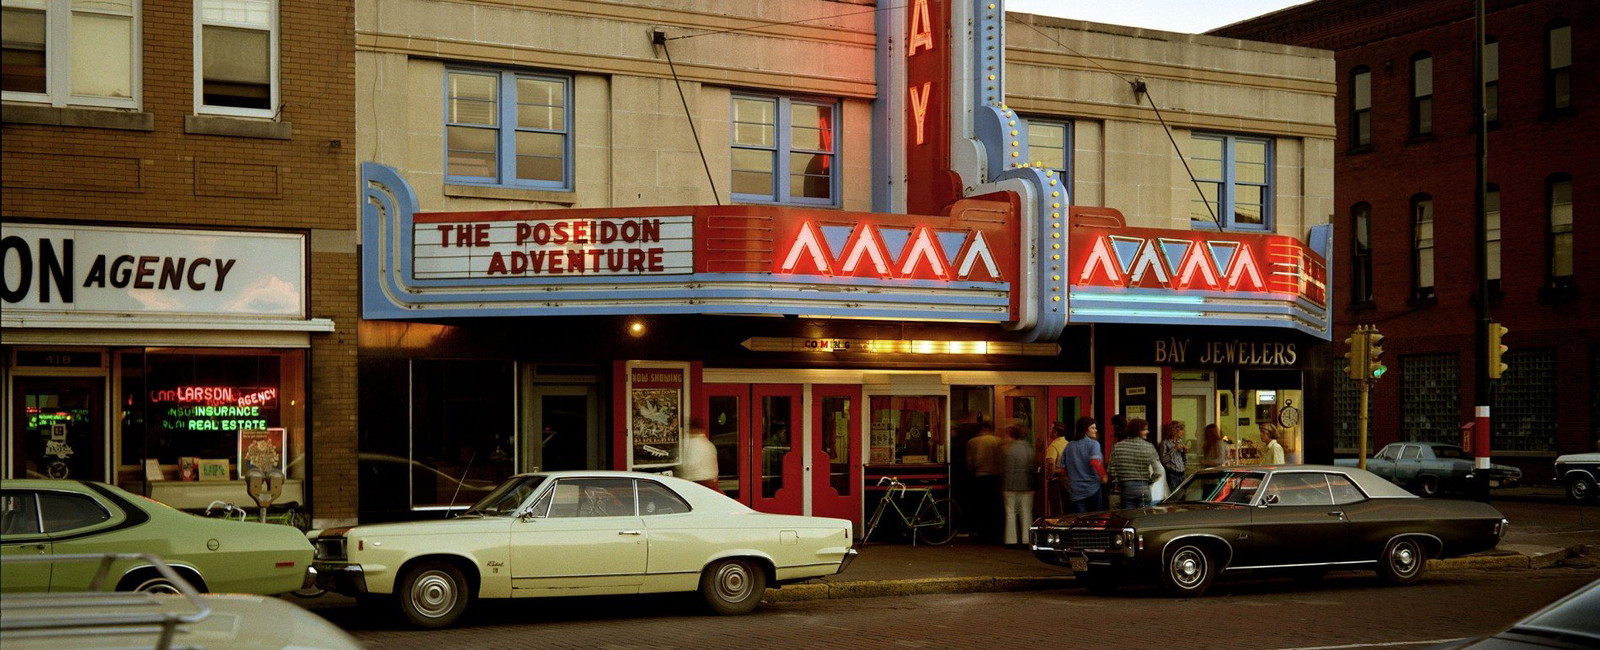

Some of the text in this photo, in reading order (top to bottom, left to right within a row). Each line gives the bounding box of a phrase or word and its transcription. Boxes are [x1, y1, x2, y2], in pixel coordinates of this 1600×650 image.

[437, 219, 660, 247] THE POSEIDON
[1, 235, 236, 303] ON AGENCY
[487, 248, 664, 275] ADVENTURE
[45, 355, 71, 365] 418
[1155, 336, 1297, 365] BAY JEWELERS
[632, 372, 683, 383] NOW SHOWING
[177, 386, 232, 401] LARSON
[237, 388, 276, 407] AGENCY
[195, 406, 259, 417] INSURANCE
[188, 419, 219, 431] REAL
[221, 419, 266, 431] ESTATE
